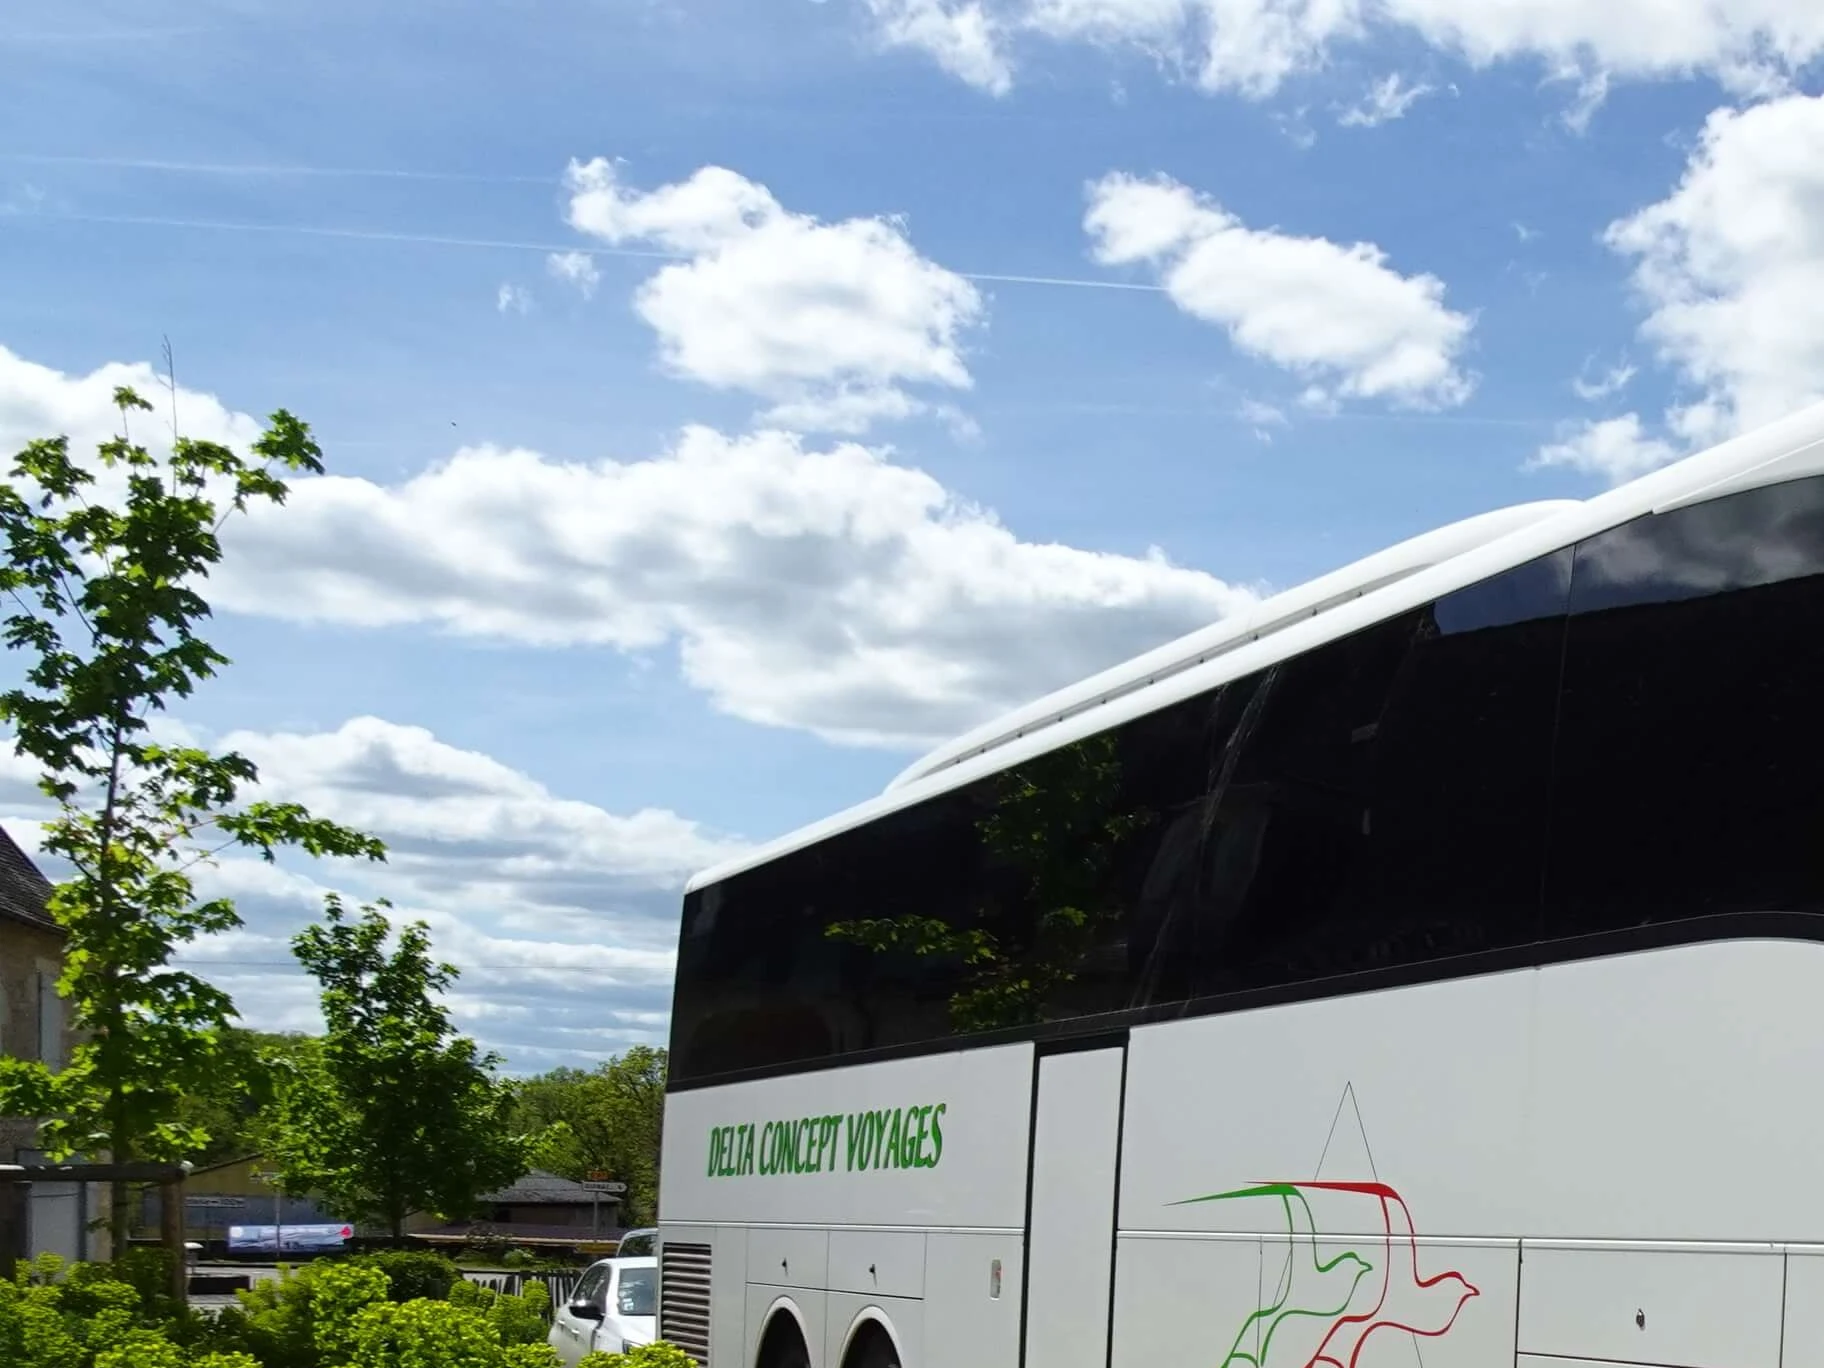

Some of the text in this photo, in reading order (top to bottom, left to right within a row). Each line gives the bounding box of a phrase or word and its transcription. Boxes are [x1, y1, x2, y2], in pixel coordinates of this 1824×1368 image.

[707, 1102, 947, 1177] DELTA CONCEPT VOYAGES
